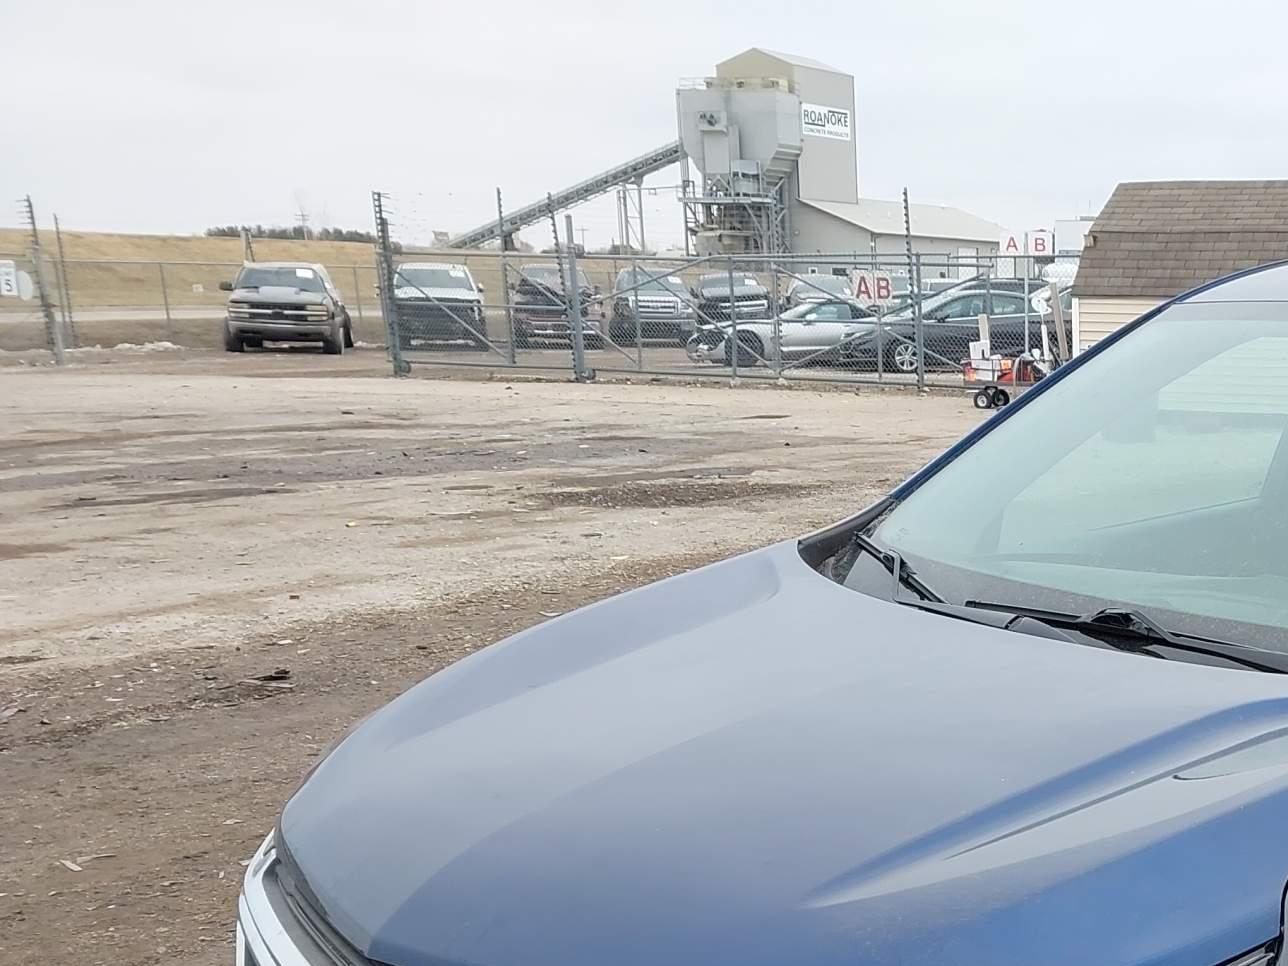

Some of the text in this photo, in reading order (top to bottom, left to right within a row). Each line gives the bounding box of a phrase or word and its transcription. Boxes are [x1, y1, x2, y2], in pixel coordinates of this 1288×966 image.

[803, 109, 849, 128] ROANOKE
[804, 126, 826, 136] CONCRETE
[1006, 236, 1047, 252] A B
[855, 275, 891, 300] A B
